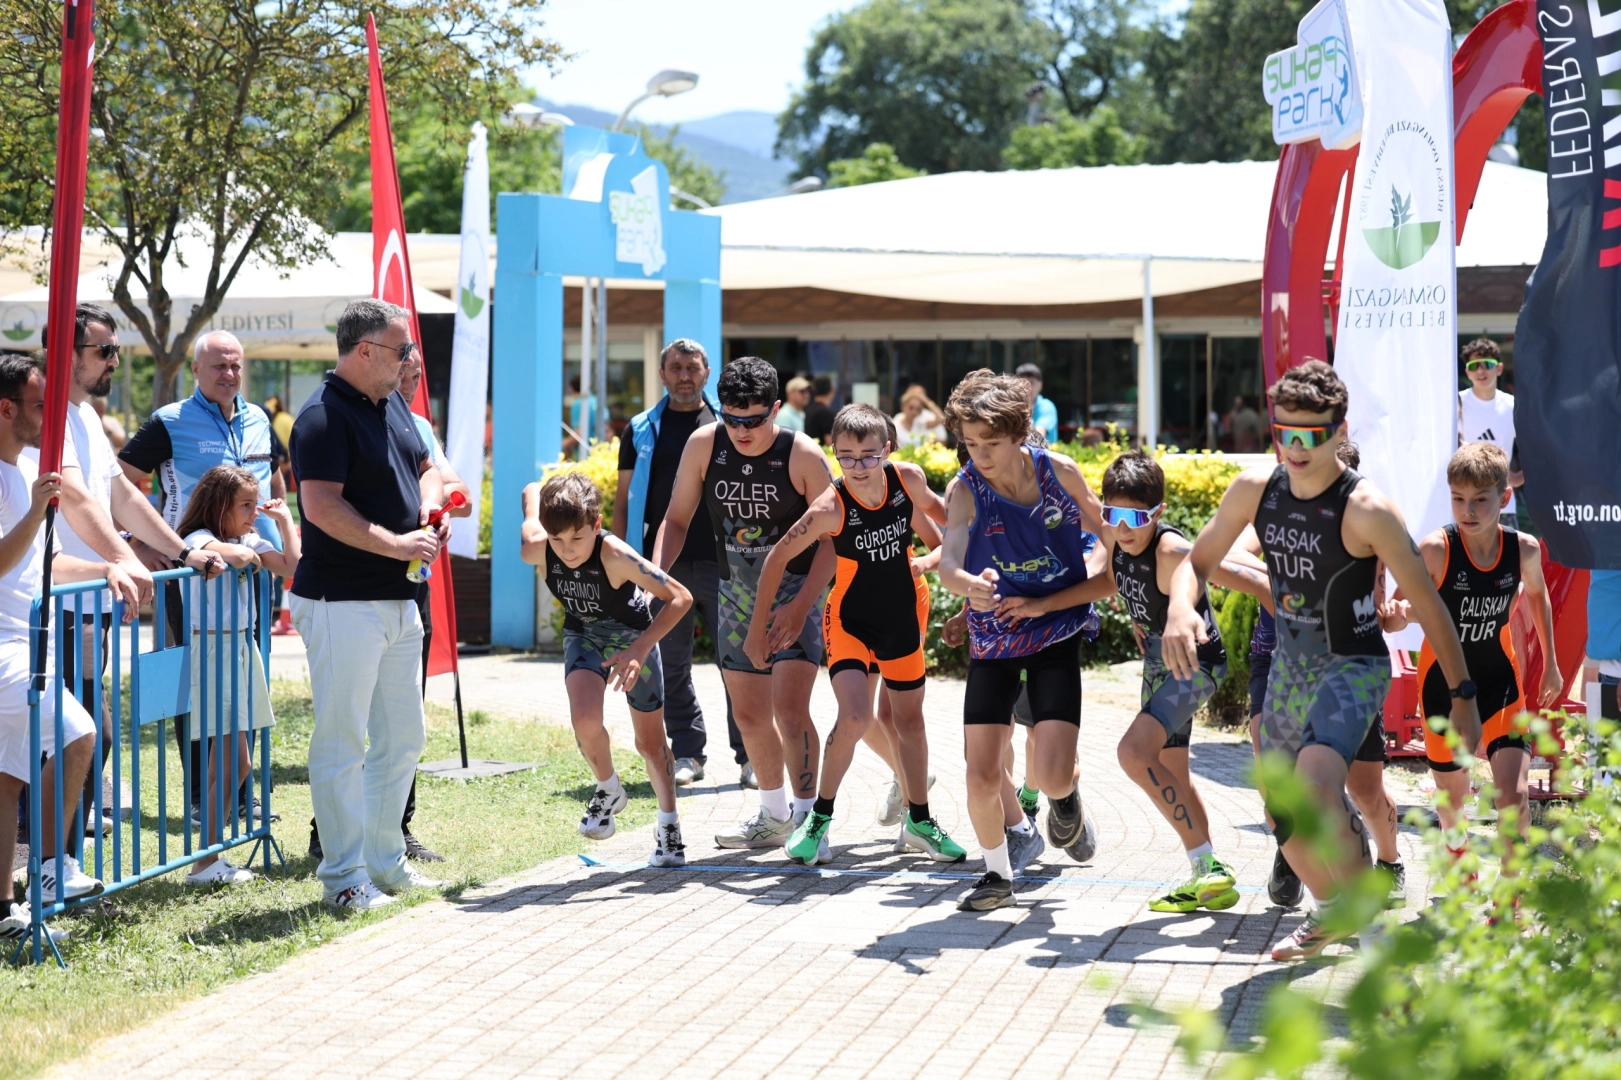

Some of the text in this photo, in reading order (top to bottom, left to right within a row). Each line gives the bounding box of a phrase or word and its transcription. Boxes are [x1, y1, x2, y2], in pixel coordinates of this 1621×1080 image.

[207, 311, 294, 332] LEDİYESİ
[714, 480, 780, 502] OZLER
[722, 502, 771, 519] TUR
[855, 515, 907, 550] GÜRDENİZ
[1264, 523, 1322, 555] BAŞAK
[867, 540, 901, 562] TUR
[1269, 550, 1316, 581] TUR
[556, 578, 601, 600] KARIMOV
[562, 596, 604, 613] TUR
[1460, 594, 1510, 622] ÇALIŞKAN
[1459, 620, 1497, 643] TUR
[799, 730, 815, 792] 112
[1146, 766, 1193, 830] 109
